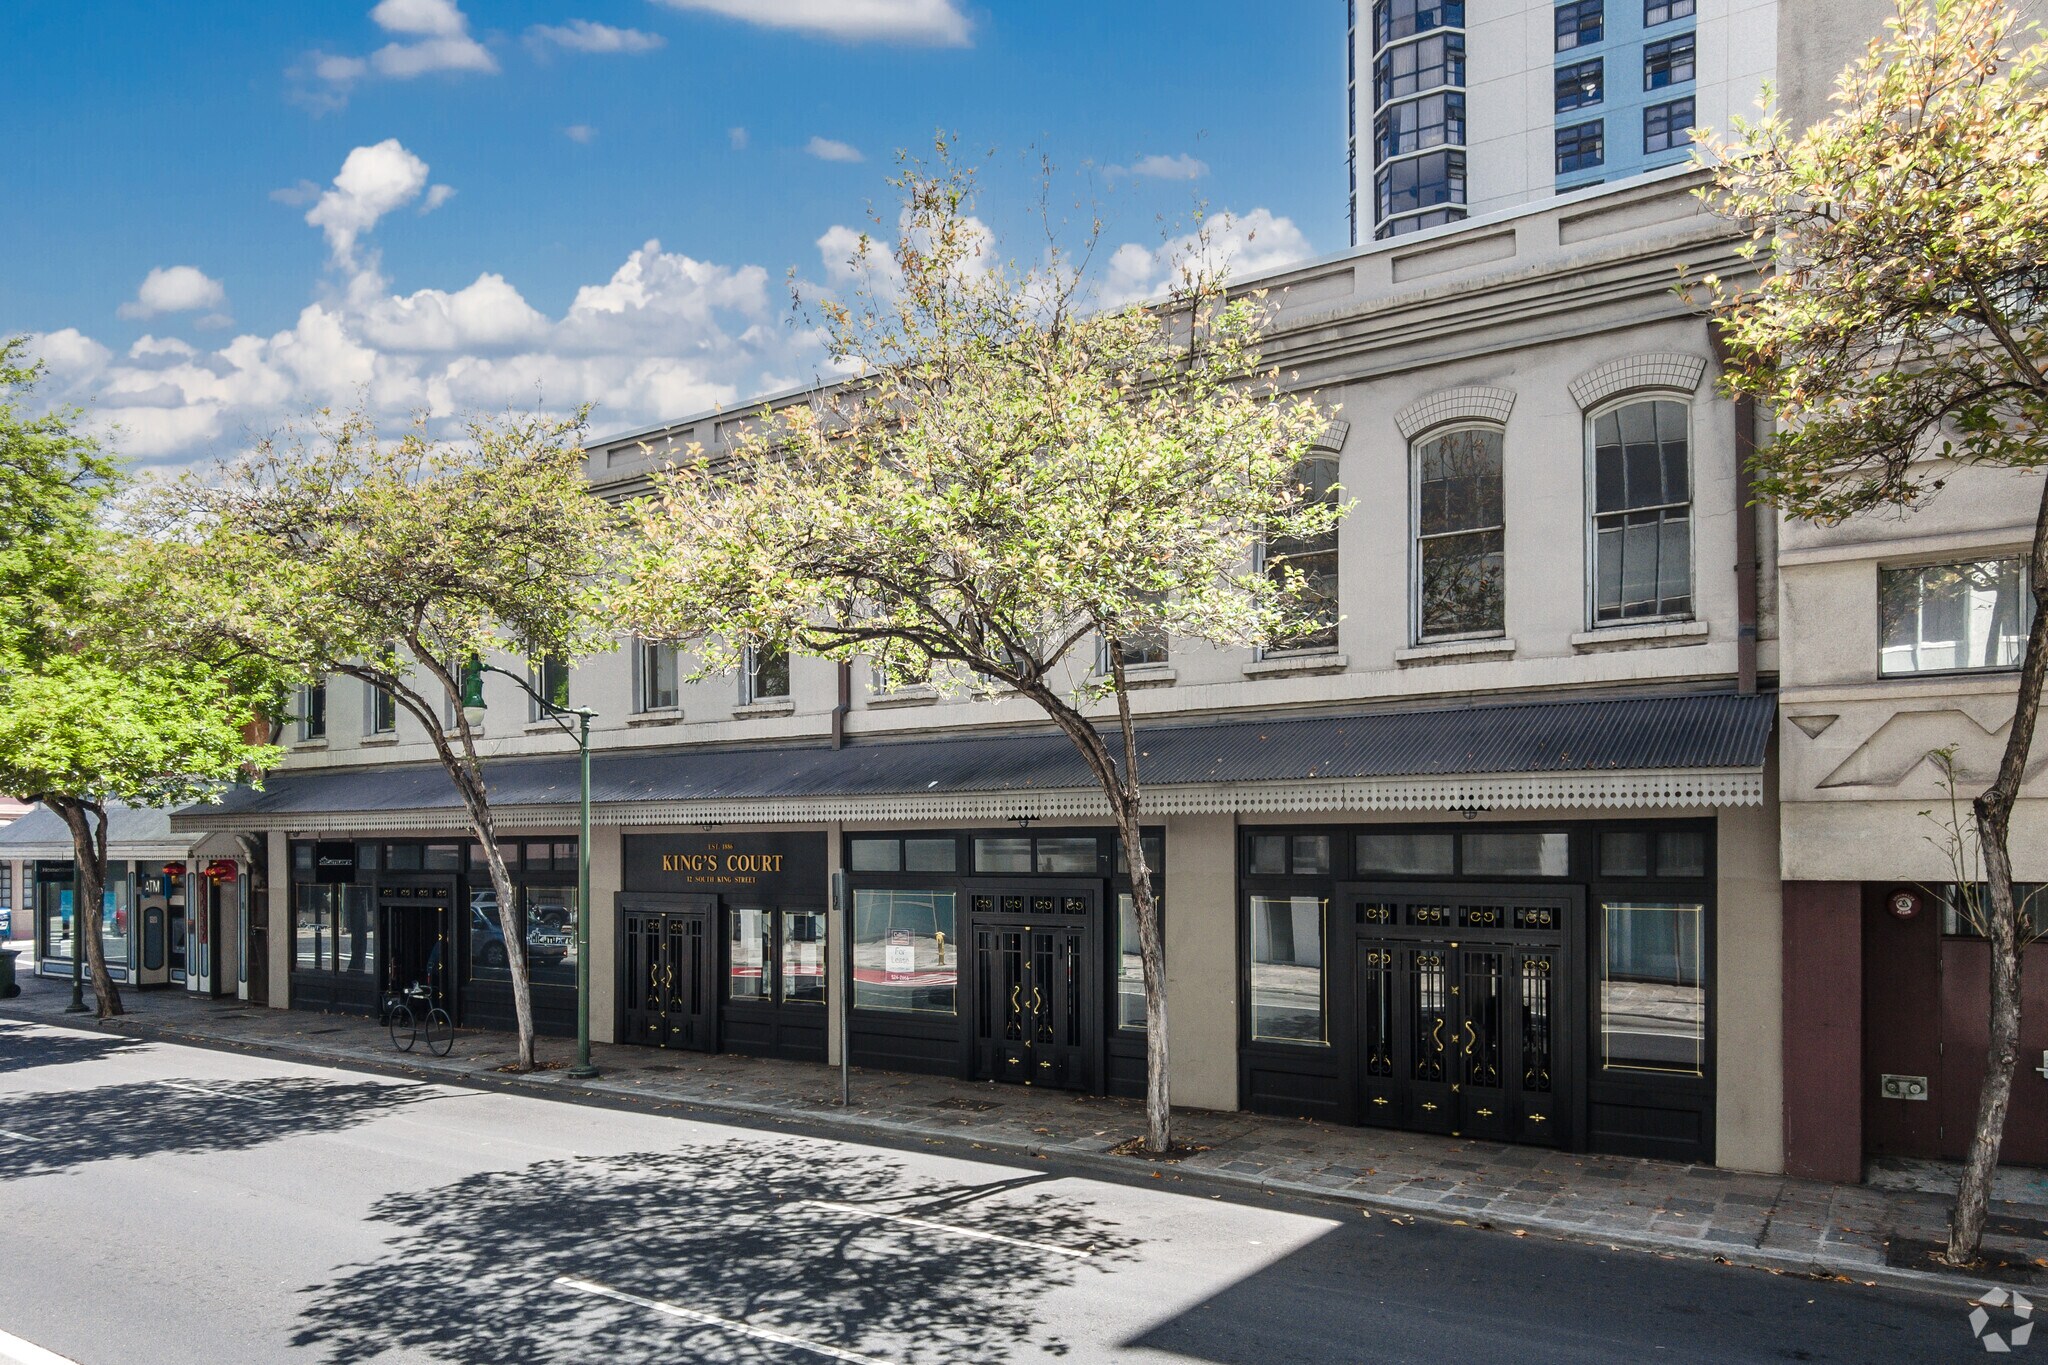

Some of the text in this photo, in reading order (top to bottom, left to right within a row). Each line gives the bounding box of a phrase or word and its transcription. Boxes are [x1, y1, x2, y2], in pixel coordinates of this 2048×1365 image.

[662, 854, 783, 872] KING'S COURT
[734, 876, 757, 884] STREET
[145, 880, 160, 893] ATM
[895, 947, 905, 955] For
